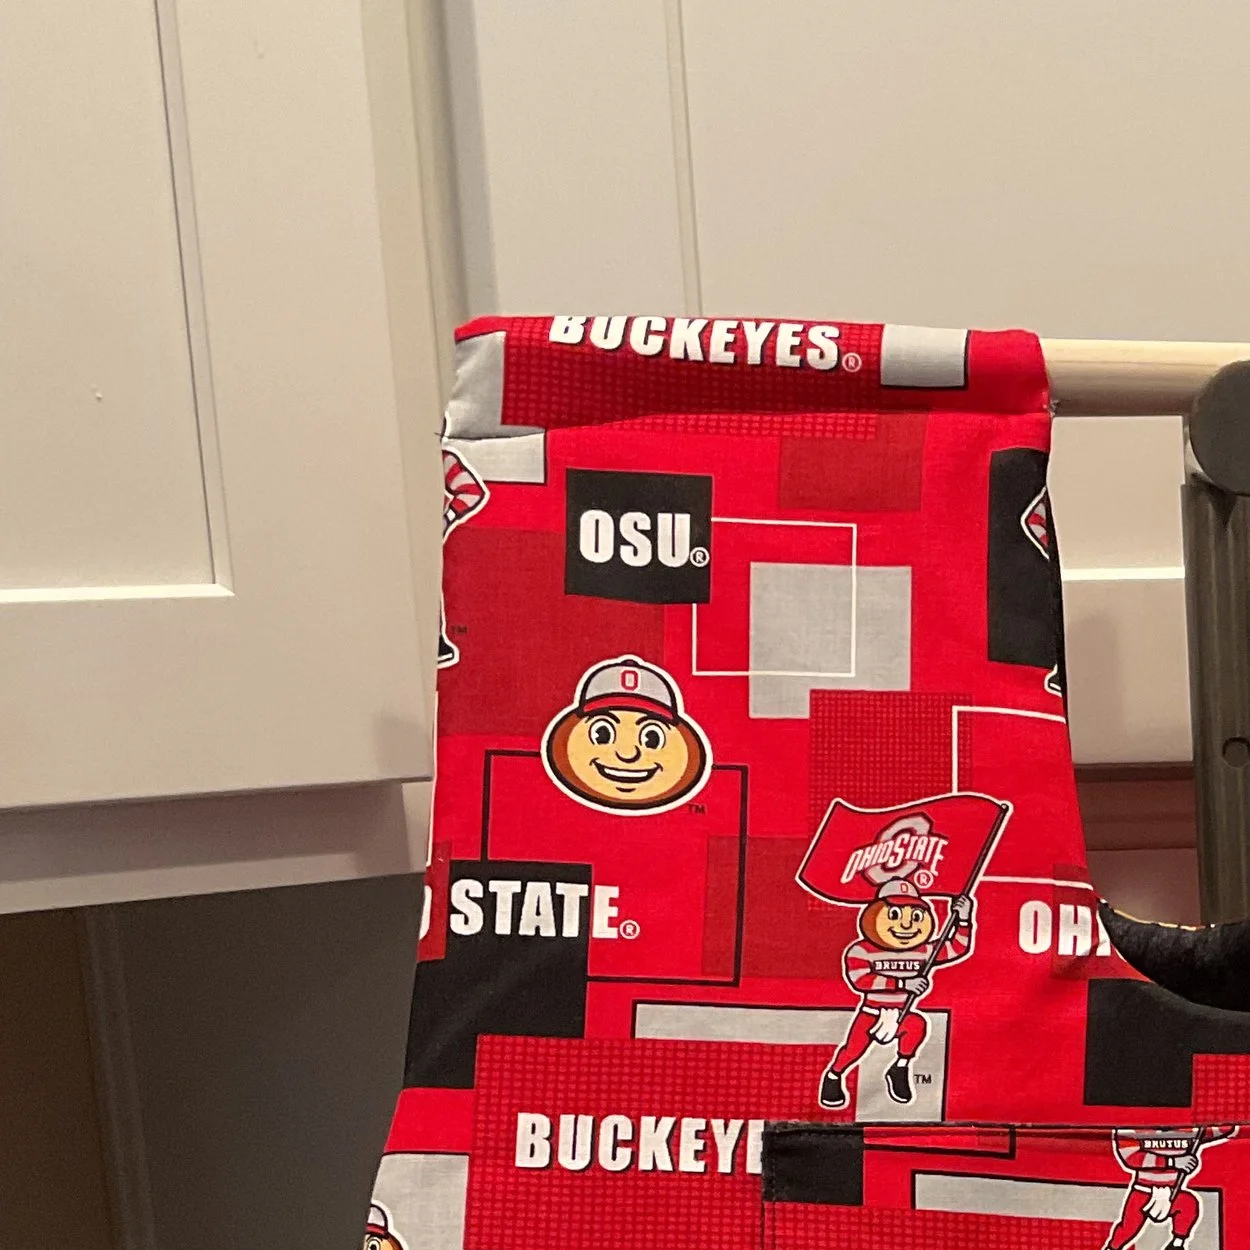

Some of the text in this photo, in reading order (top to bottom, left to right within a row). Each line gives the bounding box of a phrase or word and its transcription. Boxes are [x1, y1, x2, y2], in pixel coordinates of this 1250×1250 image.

[549, 316, 839, 370] BUCKEYES
[580, 510, 690, 567] OSU
[450, 879, 619, 938] STATE
[875, 960, 920, 970] BRUTUS
[914, 1074, 932, 1084] TM
[1144, 1139, 1188, 1149] BRUTUS
